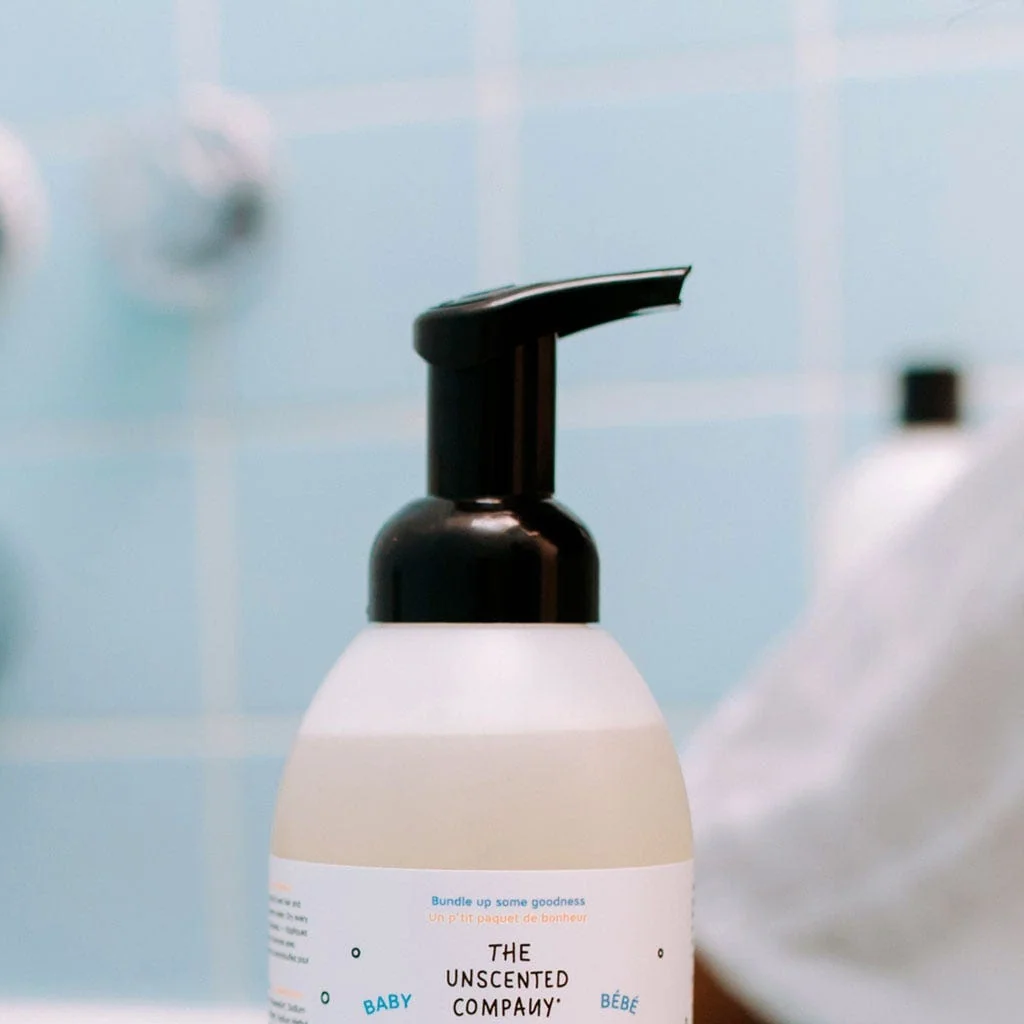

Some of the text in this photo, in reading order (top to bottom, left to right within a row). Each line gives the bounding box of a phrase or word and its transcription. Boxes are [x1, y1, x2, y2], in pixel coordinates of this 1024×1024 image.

[432, 896, 585, 909] Bundle up some goodness
[429, 913, 444, 922] Un
[477, 913, 519, 924] paquet
[523, 913, 537, 922] de
[542, 912, 588, 923] bonheur
[488, 942, 531, 963] THE
[446, 969, 568, 988] UNSCENTED
[363, 993, 411, 1015] BABY
[601, 989, 639, 1015] BÉBÉ
